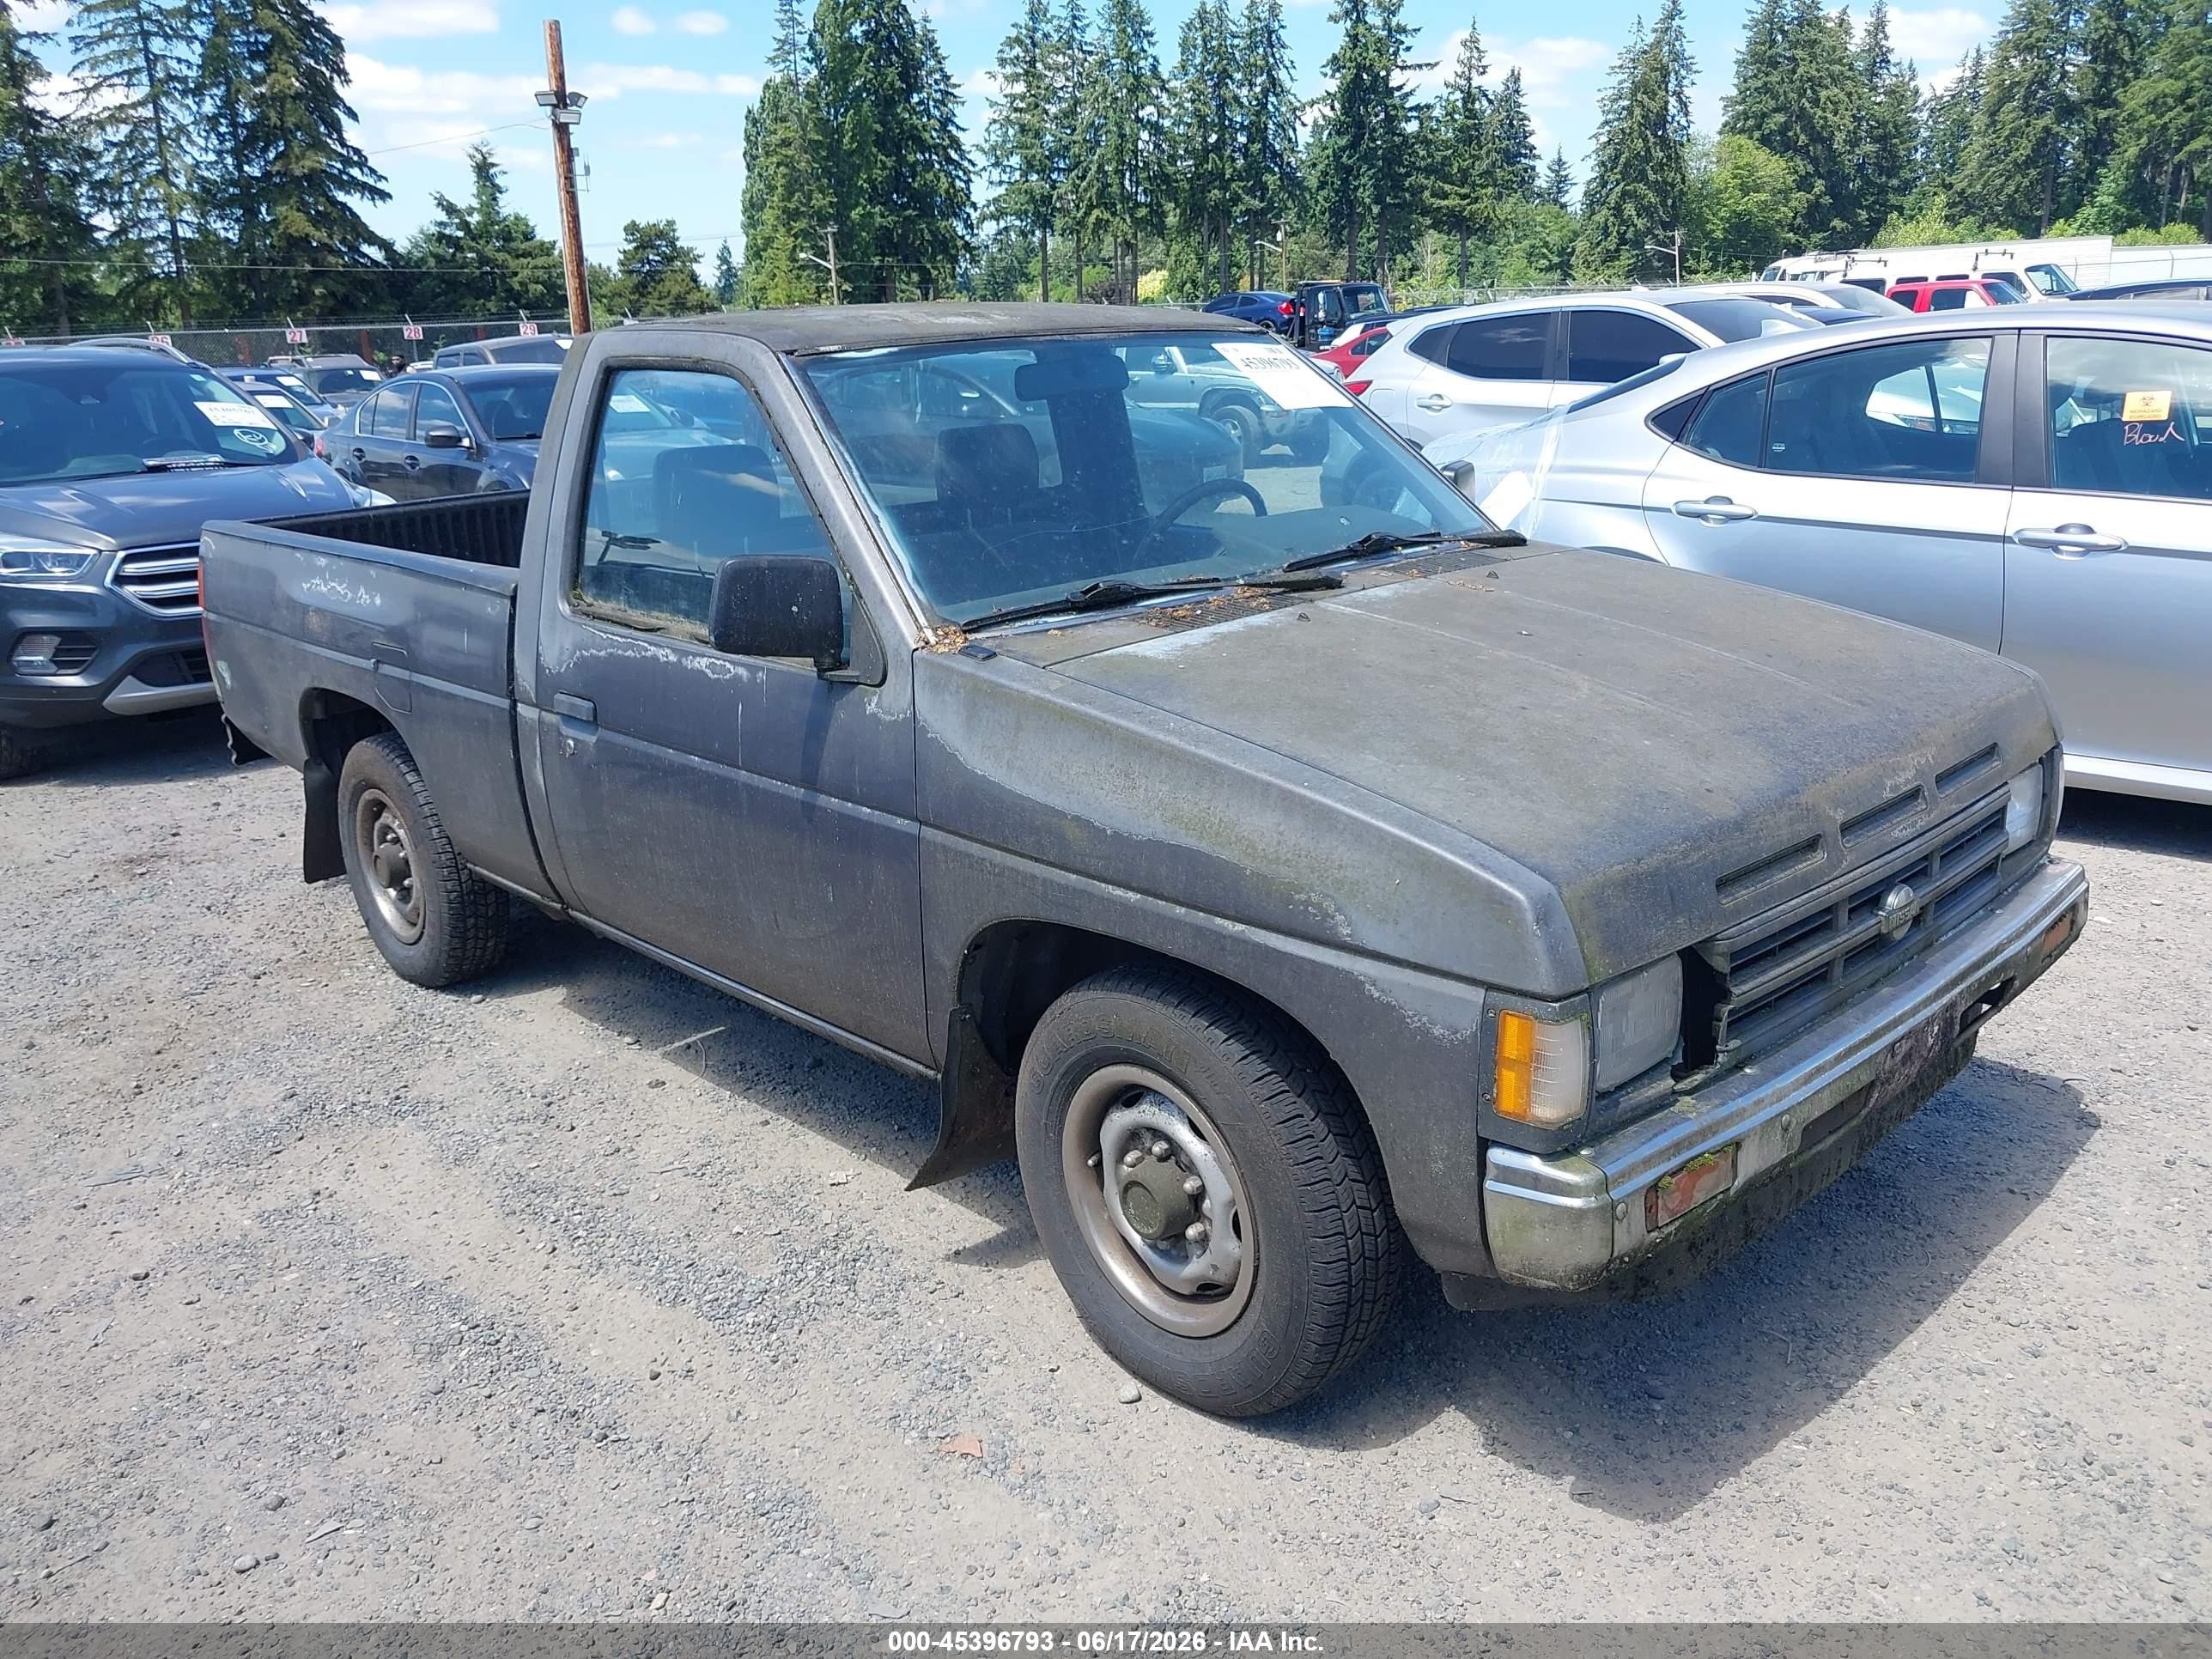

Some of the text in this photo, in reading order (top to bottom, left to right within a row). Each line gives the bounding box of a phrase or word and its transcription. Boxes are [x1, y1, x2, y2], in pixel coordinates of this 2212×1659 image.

[405, 326, 421, 338] 28
[521, 324, 536, 336] 29
[289, 330, 303, 343] 27
